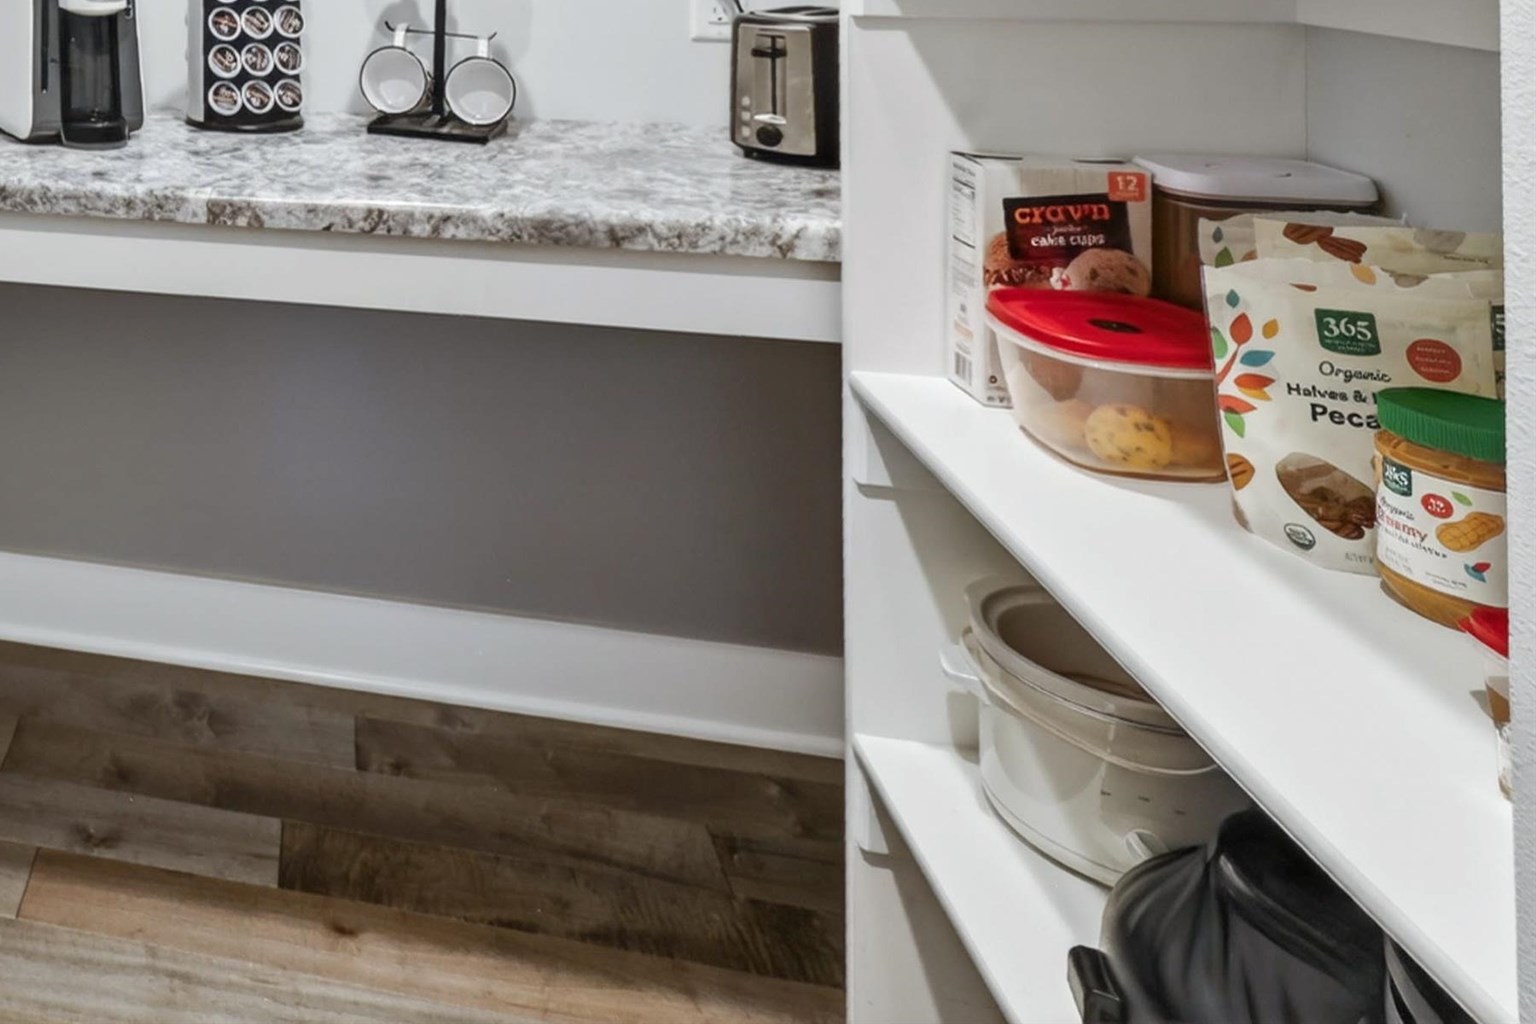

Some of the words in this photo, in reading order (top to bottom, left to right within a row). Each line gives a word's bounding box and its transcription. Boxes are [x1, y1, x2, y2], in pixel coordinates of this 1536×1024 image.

[1116, 175, 1138, 191] 12
[1323, 317, 1372, 341] 365
[1319, 360, 1392, 383] Organic
[1286, 382, 1349, 402] Halves
[1353, 390, 1367, 404] &
[1310, 403, 1381, 430] Peca
